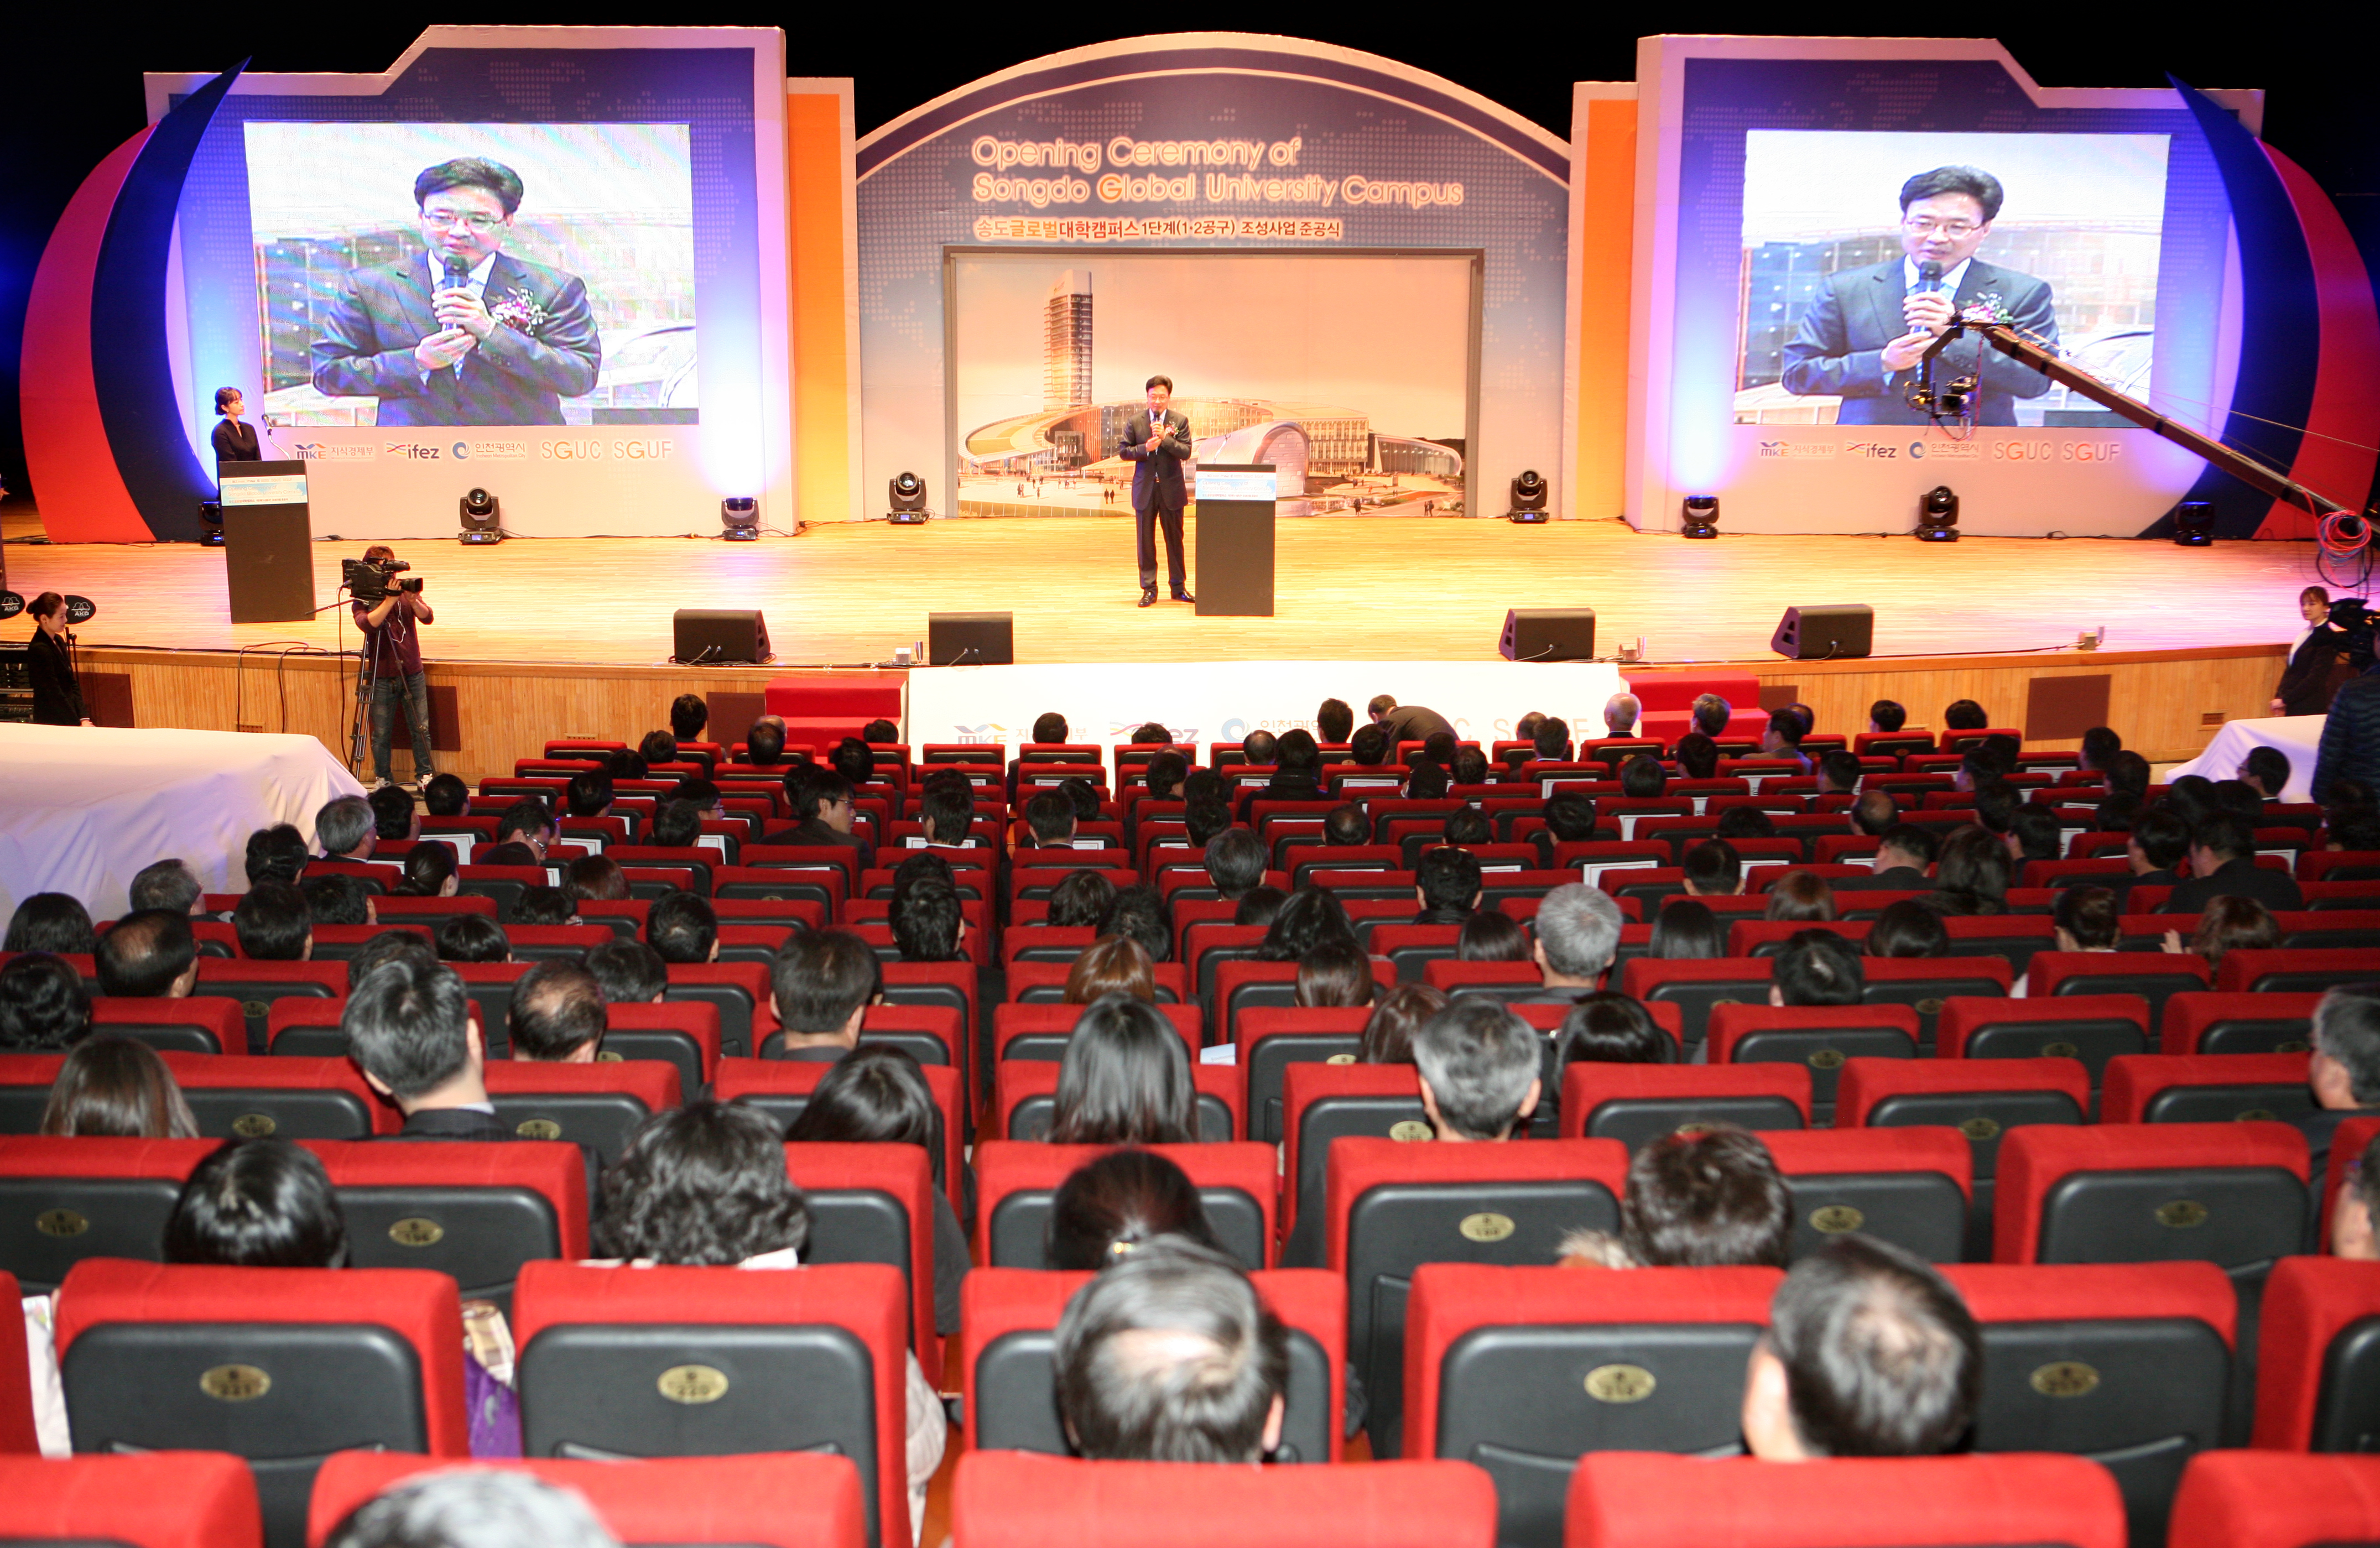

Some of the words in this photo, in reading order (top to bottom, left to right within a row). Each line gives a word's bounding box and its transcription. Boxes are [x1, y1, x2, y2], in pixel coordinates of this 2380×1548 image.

[973, 137, 1100, 171] Opening
[1108, 137, 1264, 170] Ceremony
[1270, 138, 1300, 164] of
[974, 174, 1089, 206] Songdo
[1098, 174, 1194, 202] Global
[1207, 174, 1337, 205] University
[1342, 176, 1463, 208] Campus
[1241, 220, 1295, 236] 조성사업
[1299, 221, 1340, 237] 준공식
[330, 446, 374, 456] 지식경제부
[408, 444, 440, 459] ifez
[475, 442, 525, 452] 인천광역시
[541, 441, 601, 459] SGUC
[614, 441, 671, 459] SGUF
[1866, 443, 1897, 458] ifez
[1994, 442, 2051, 460] SGUC
[2063, 443, 2119, 461] SGUF
